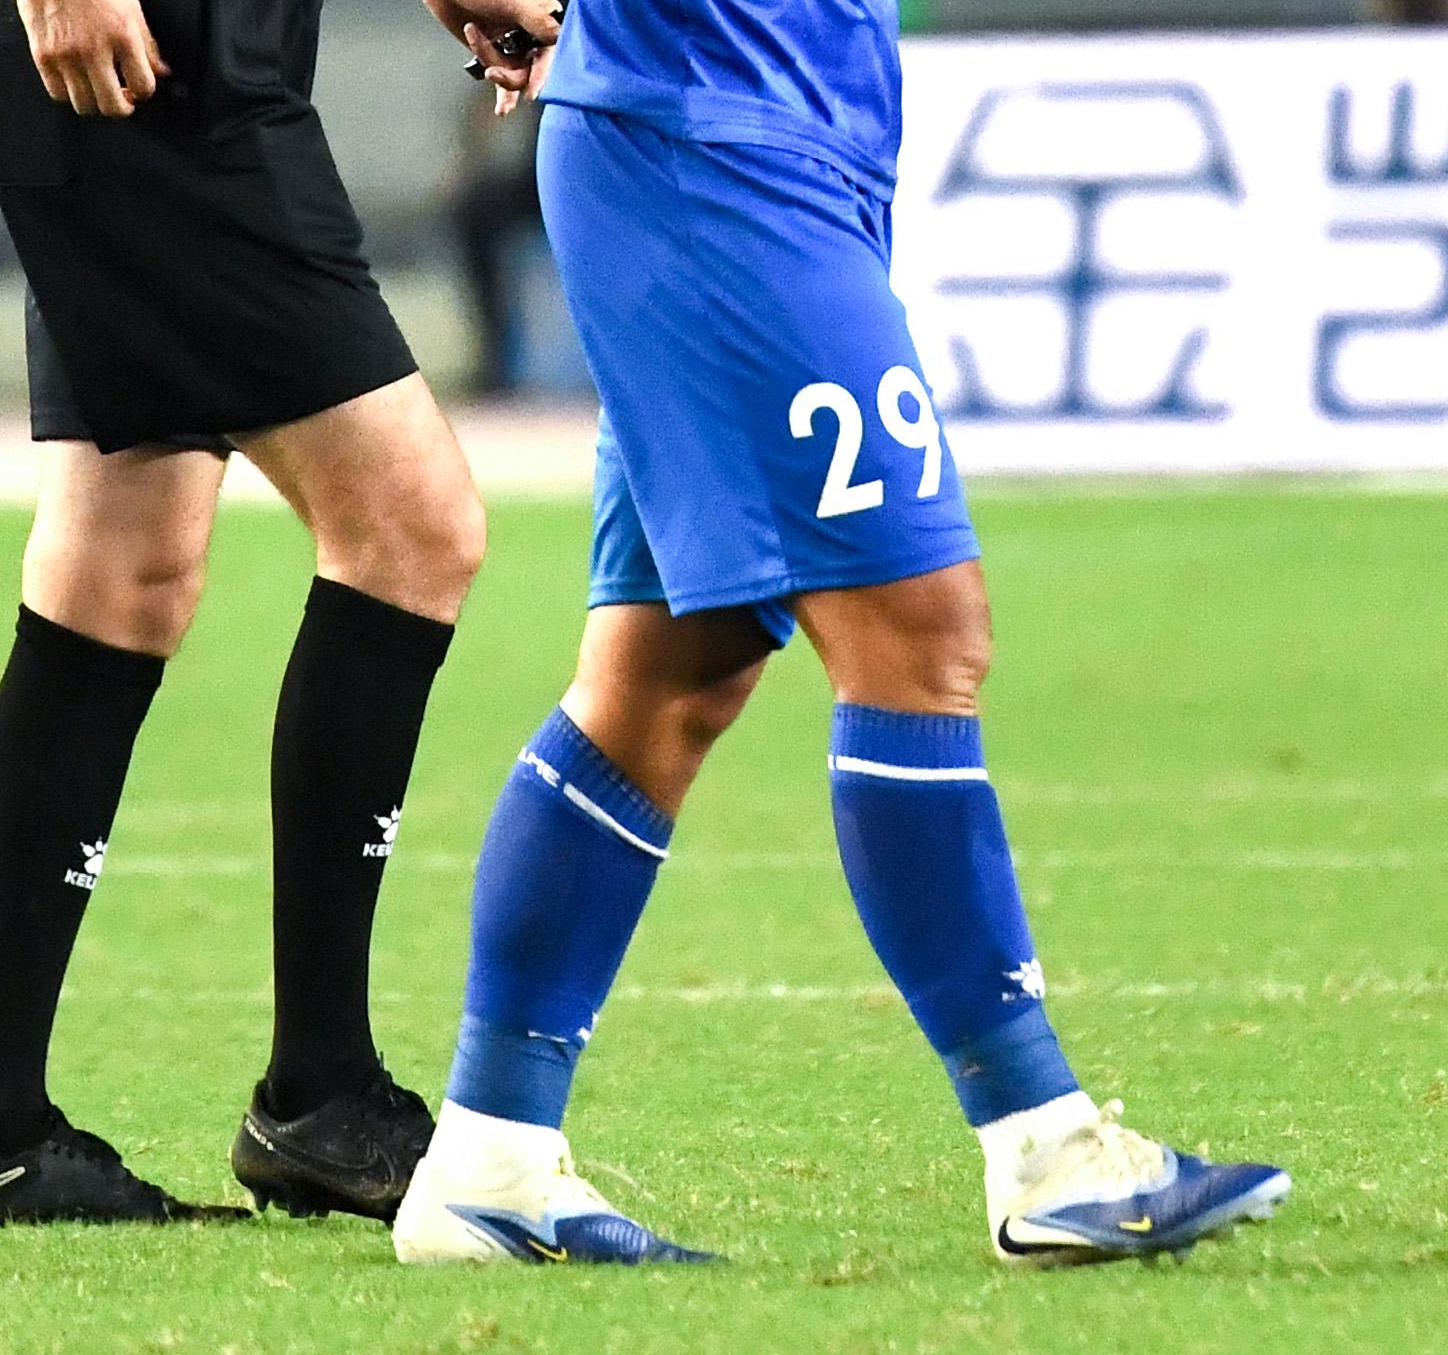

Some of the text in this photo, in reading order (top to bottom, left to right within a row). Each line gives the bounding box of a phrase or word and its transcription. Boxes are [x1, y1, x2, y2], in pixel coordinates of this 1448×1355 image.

[788, 364, 943, 520] 29
[362, 842, 394, 857] KEL
[64, 868, 98, 890] KEL
